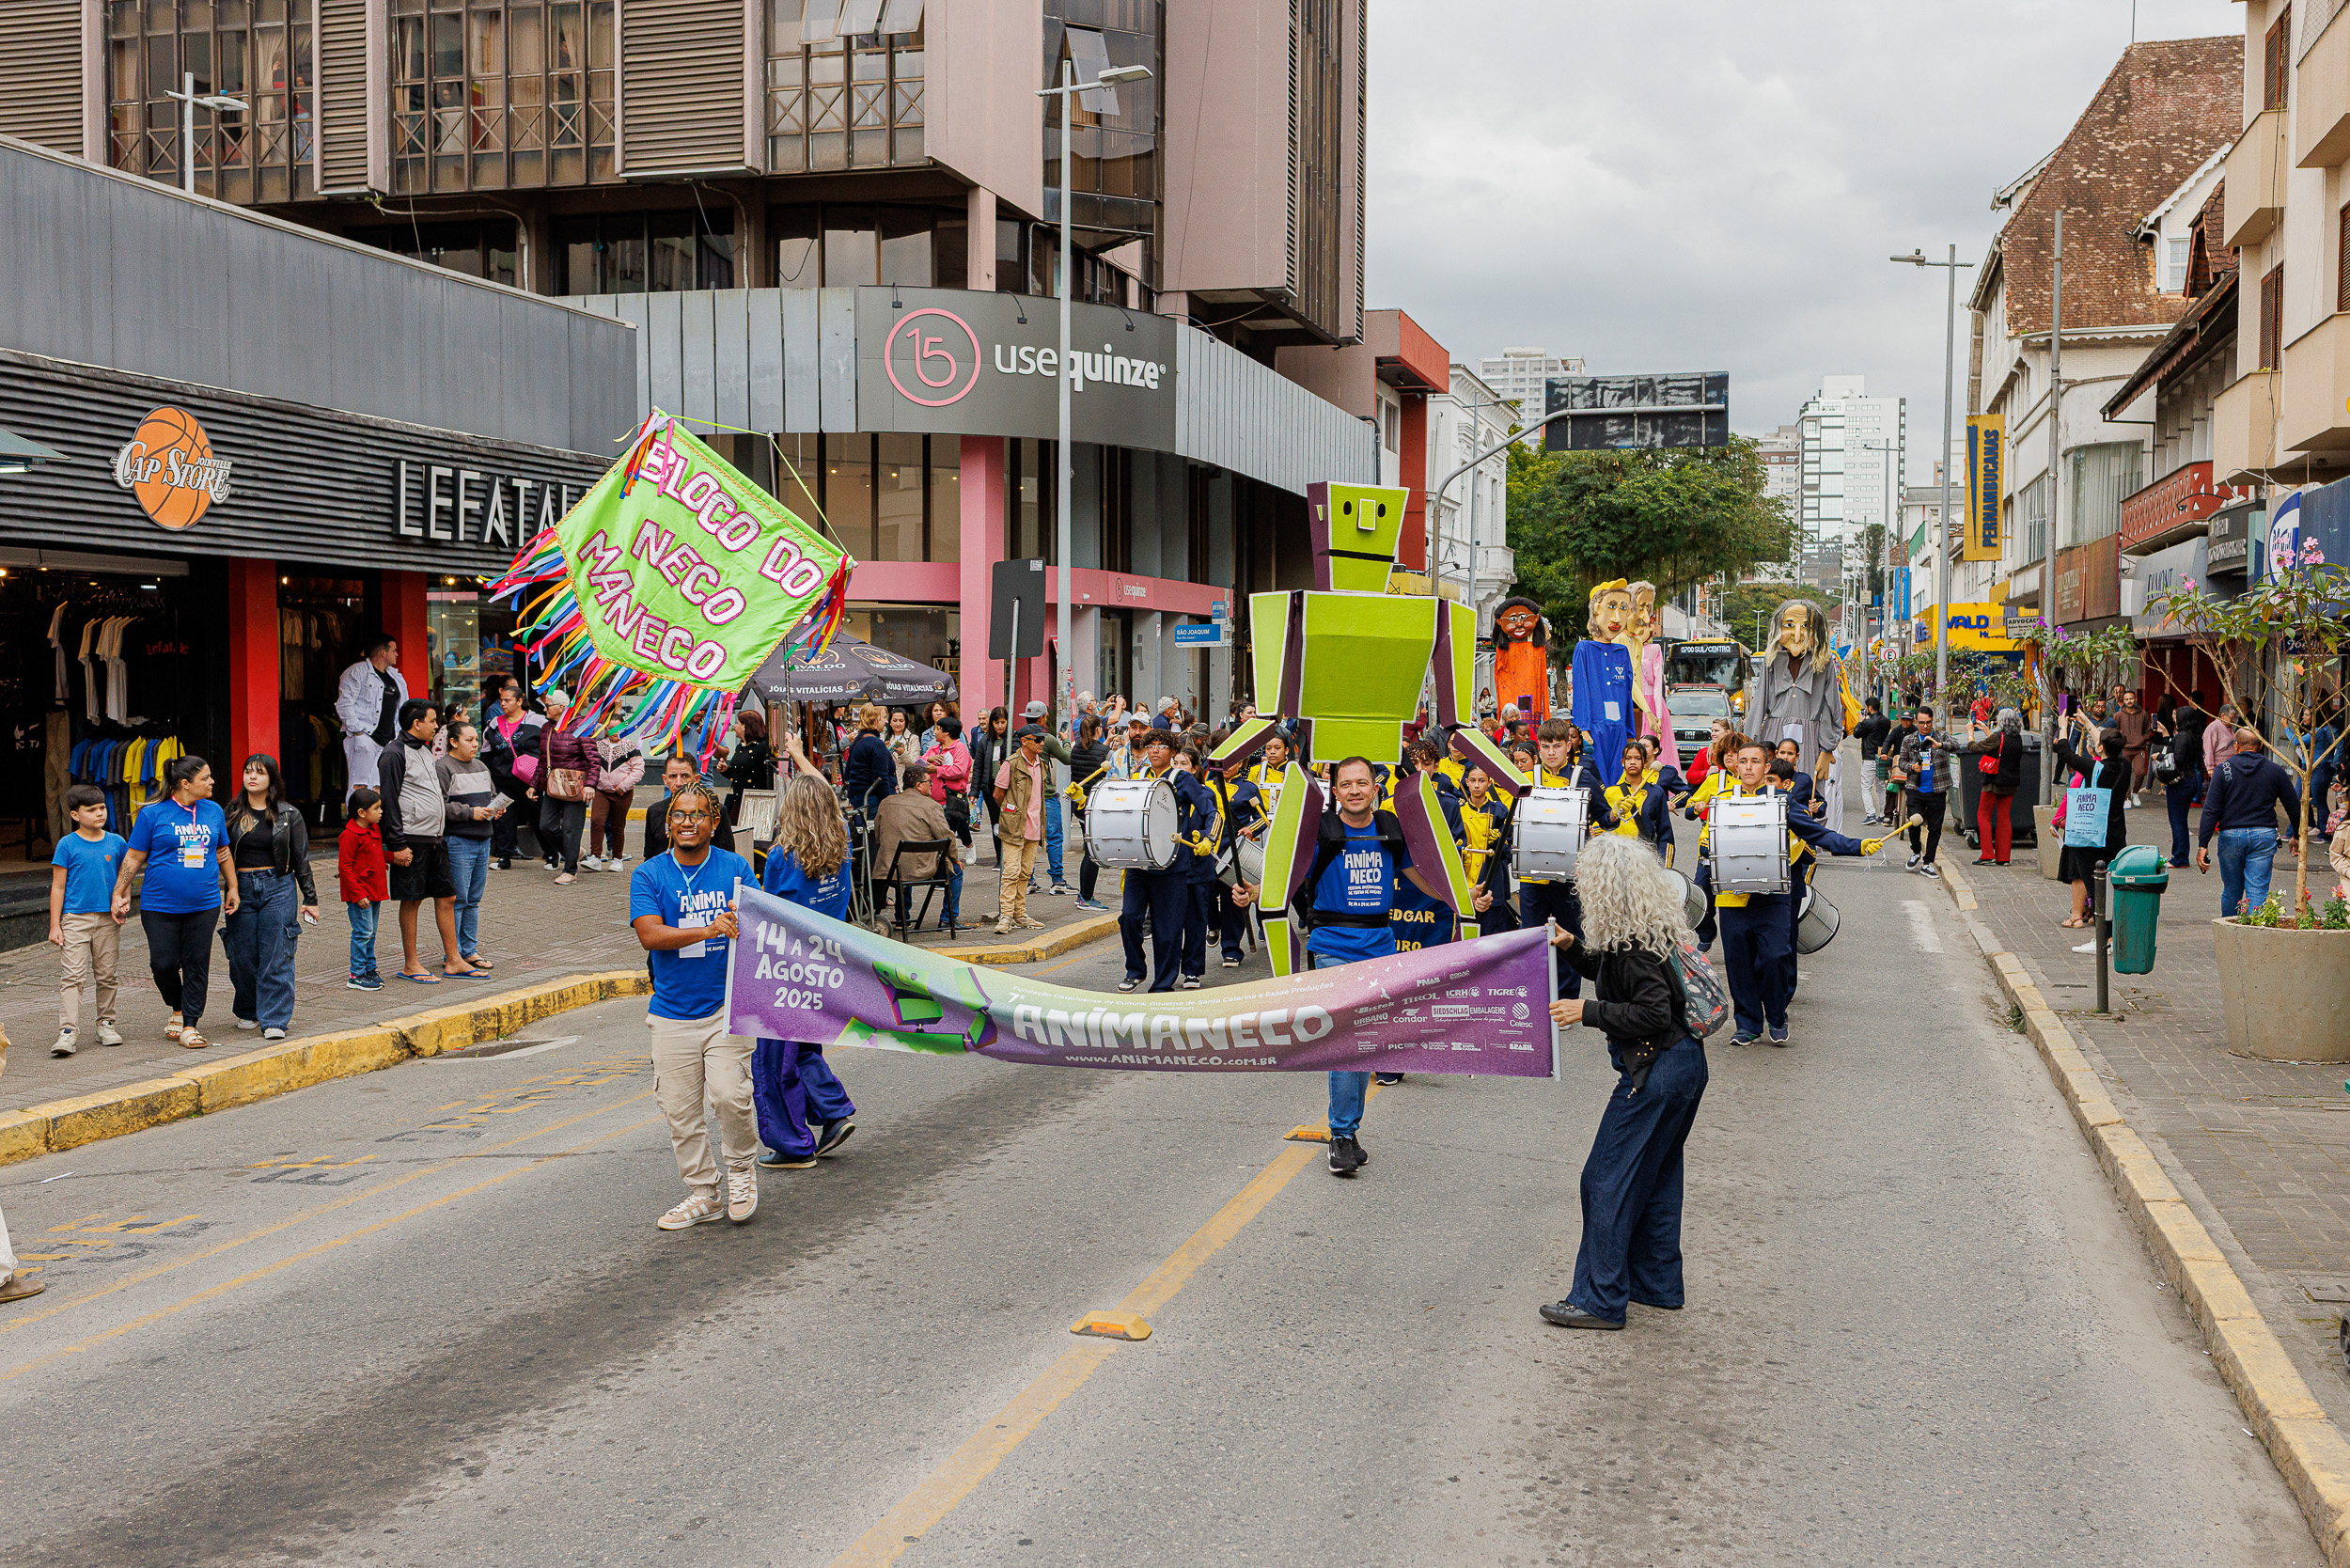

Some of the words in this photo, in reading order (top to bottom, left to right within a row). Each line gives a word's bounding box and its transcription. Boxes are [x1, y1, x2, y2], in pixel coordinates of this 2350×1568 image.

[111, 440, 162, 488] CAP
[162, 447, 232, 504] STORE
[196, 457, 232, 470] JOINVILLE
[1982, 429, 1999, 547] PERNAMBUCANAS
[399, 460, 568, 548] LEFATA
[639, 440, 761, 553] BLOCO
[758, 536, 823, 598] DO
[631, 519, 746, 626] NECO
[577, 529, 727, 680] MANECO
[769, 685, 794, 694] JÓIAS
[796, 684, 843, 694] VITALÍCIAS
[902, 682, 933, 692] VITALÍCIAS
[1350, 868, 1382, 884] NECO
[756, 921, 786, 955] 14
[790, 938, 801, 956] A
[808, 934, 846, 964] 24
[754, 953, 844, 989] AGOSTO
[774, 987, 823, 1010] 2025
[1013, 986, 1052, 999] Fundação
[1054, 994, 1102, 1004] Catarinense
[1222, 994, 1257, 1004] Catarina
[1292, 981, 1334, 995] Produções
[1354, 1012, 1388, 1025] URBANO
[1470, 1006, 1506, 1015] EMBALAGENS
[1510, 1019, 1533, 1028] Celesc
